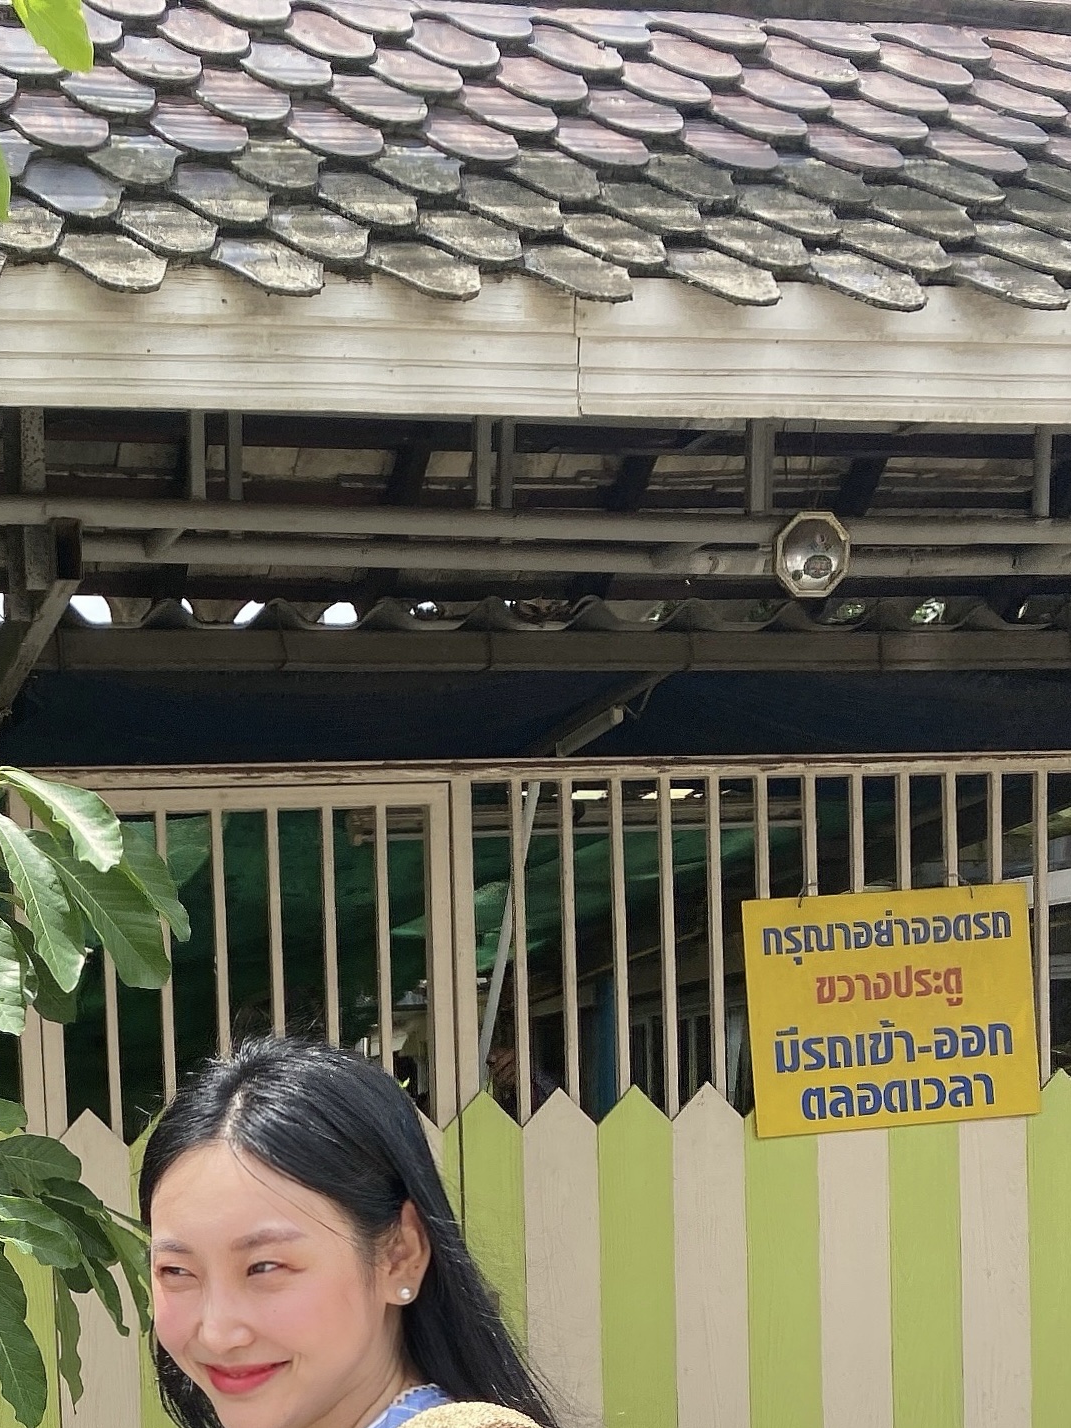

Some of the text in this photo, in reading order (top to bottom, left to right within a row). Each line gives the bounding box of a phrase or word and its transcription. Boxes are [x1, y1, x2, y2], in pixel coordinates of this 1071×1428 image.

[762, 910, 1011, 965] กรุณาอย่าจอดรถ
[816, 965, 963, 1006] ขวางประตู
[775, 1020, 1013, 1073] มีรถเข้า-ออก
[802, 1073, 995, 1120] ตลอดเวลา
